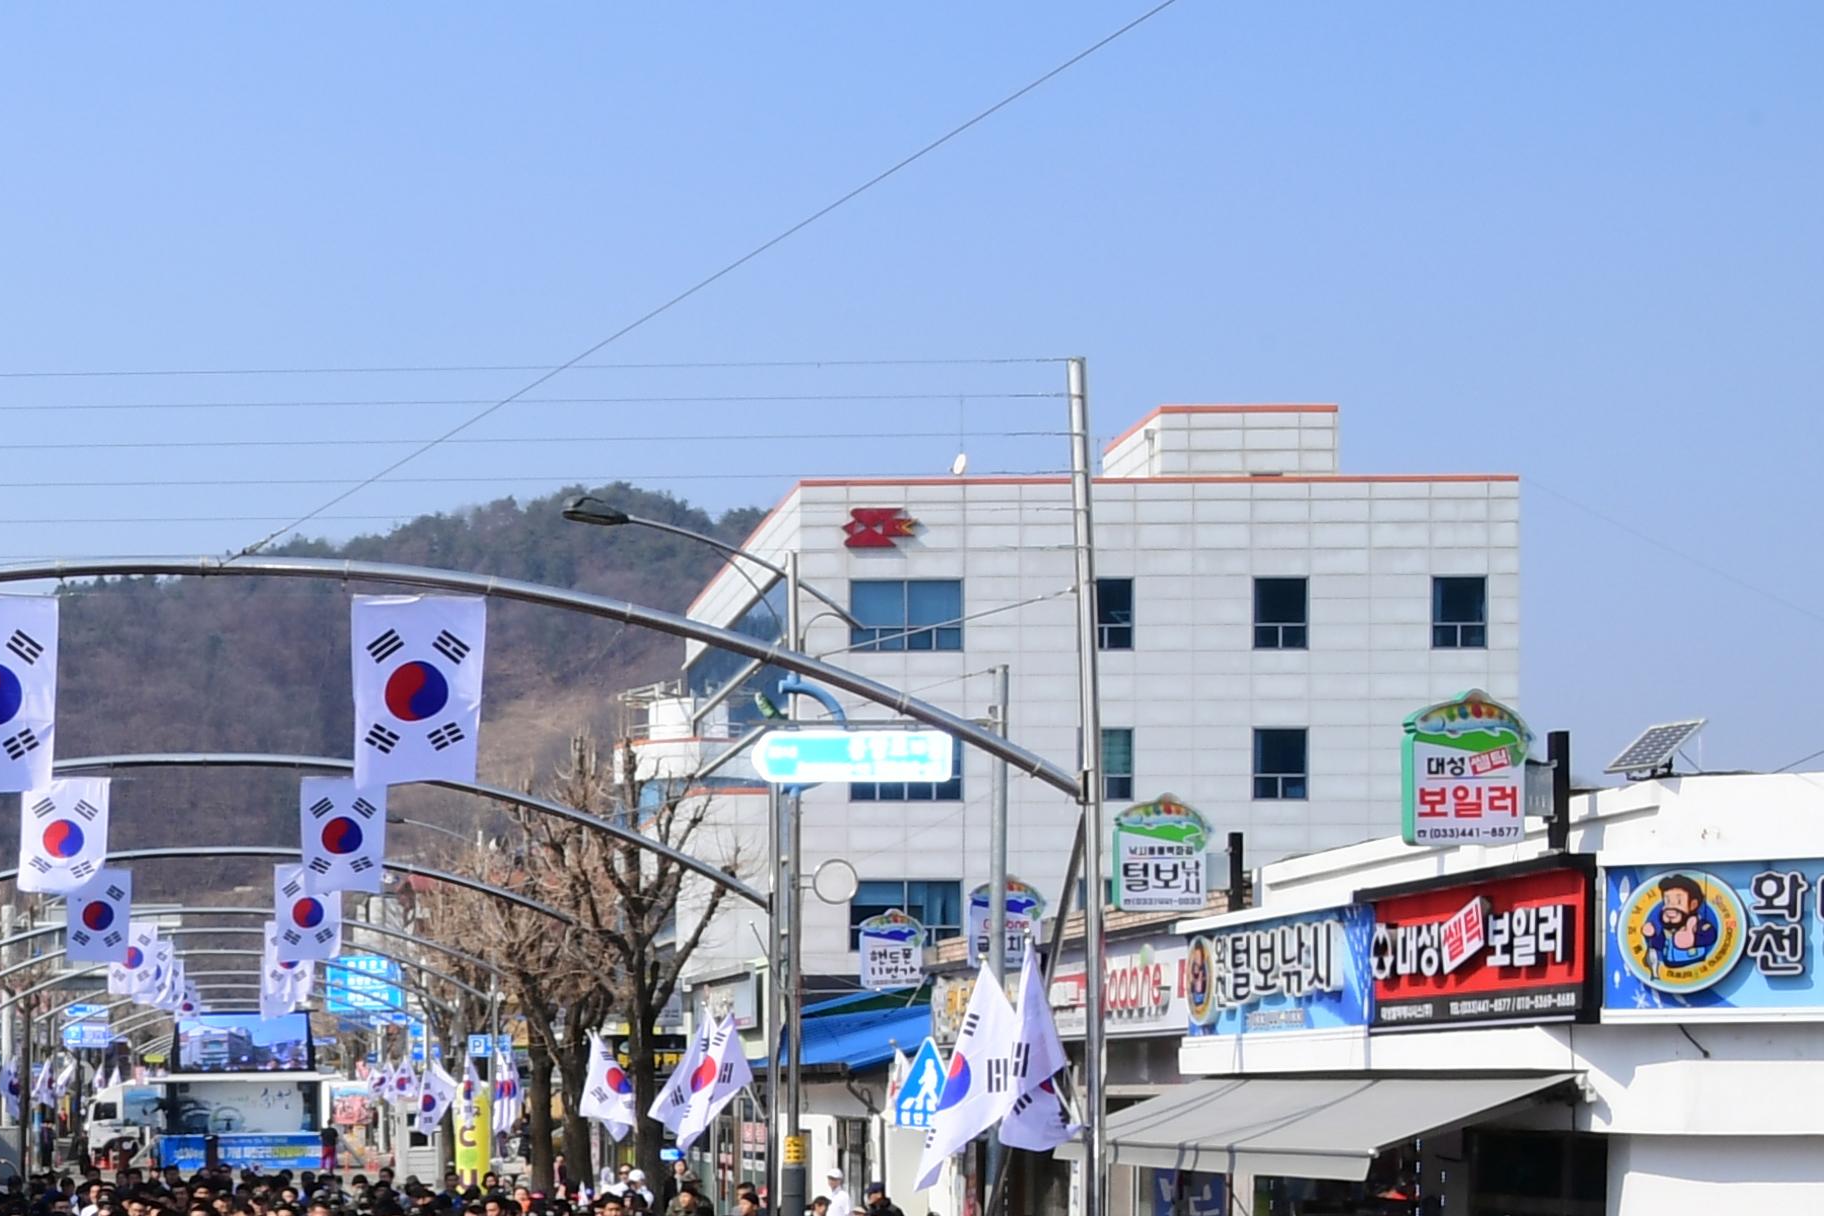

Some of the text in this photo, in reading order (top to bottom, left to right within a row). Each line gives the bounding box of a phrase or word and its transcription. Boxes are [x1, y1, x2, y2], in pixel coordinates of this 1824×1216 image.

[1427, 757, 1465, 776] 대성
[1417, 784, 1519, 819] 보일러
[1230, 922, 1334, 1002] 털보낚시
[1396, 922, 1439, 977] 대성
[1486, 903, 1564, 967] 보일러
[1104, 962, 1164, 1009] oobne
